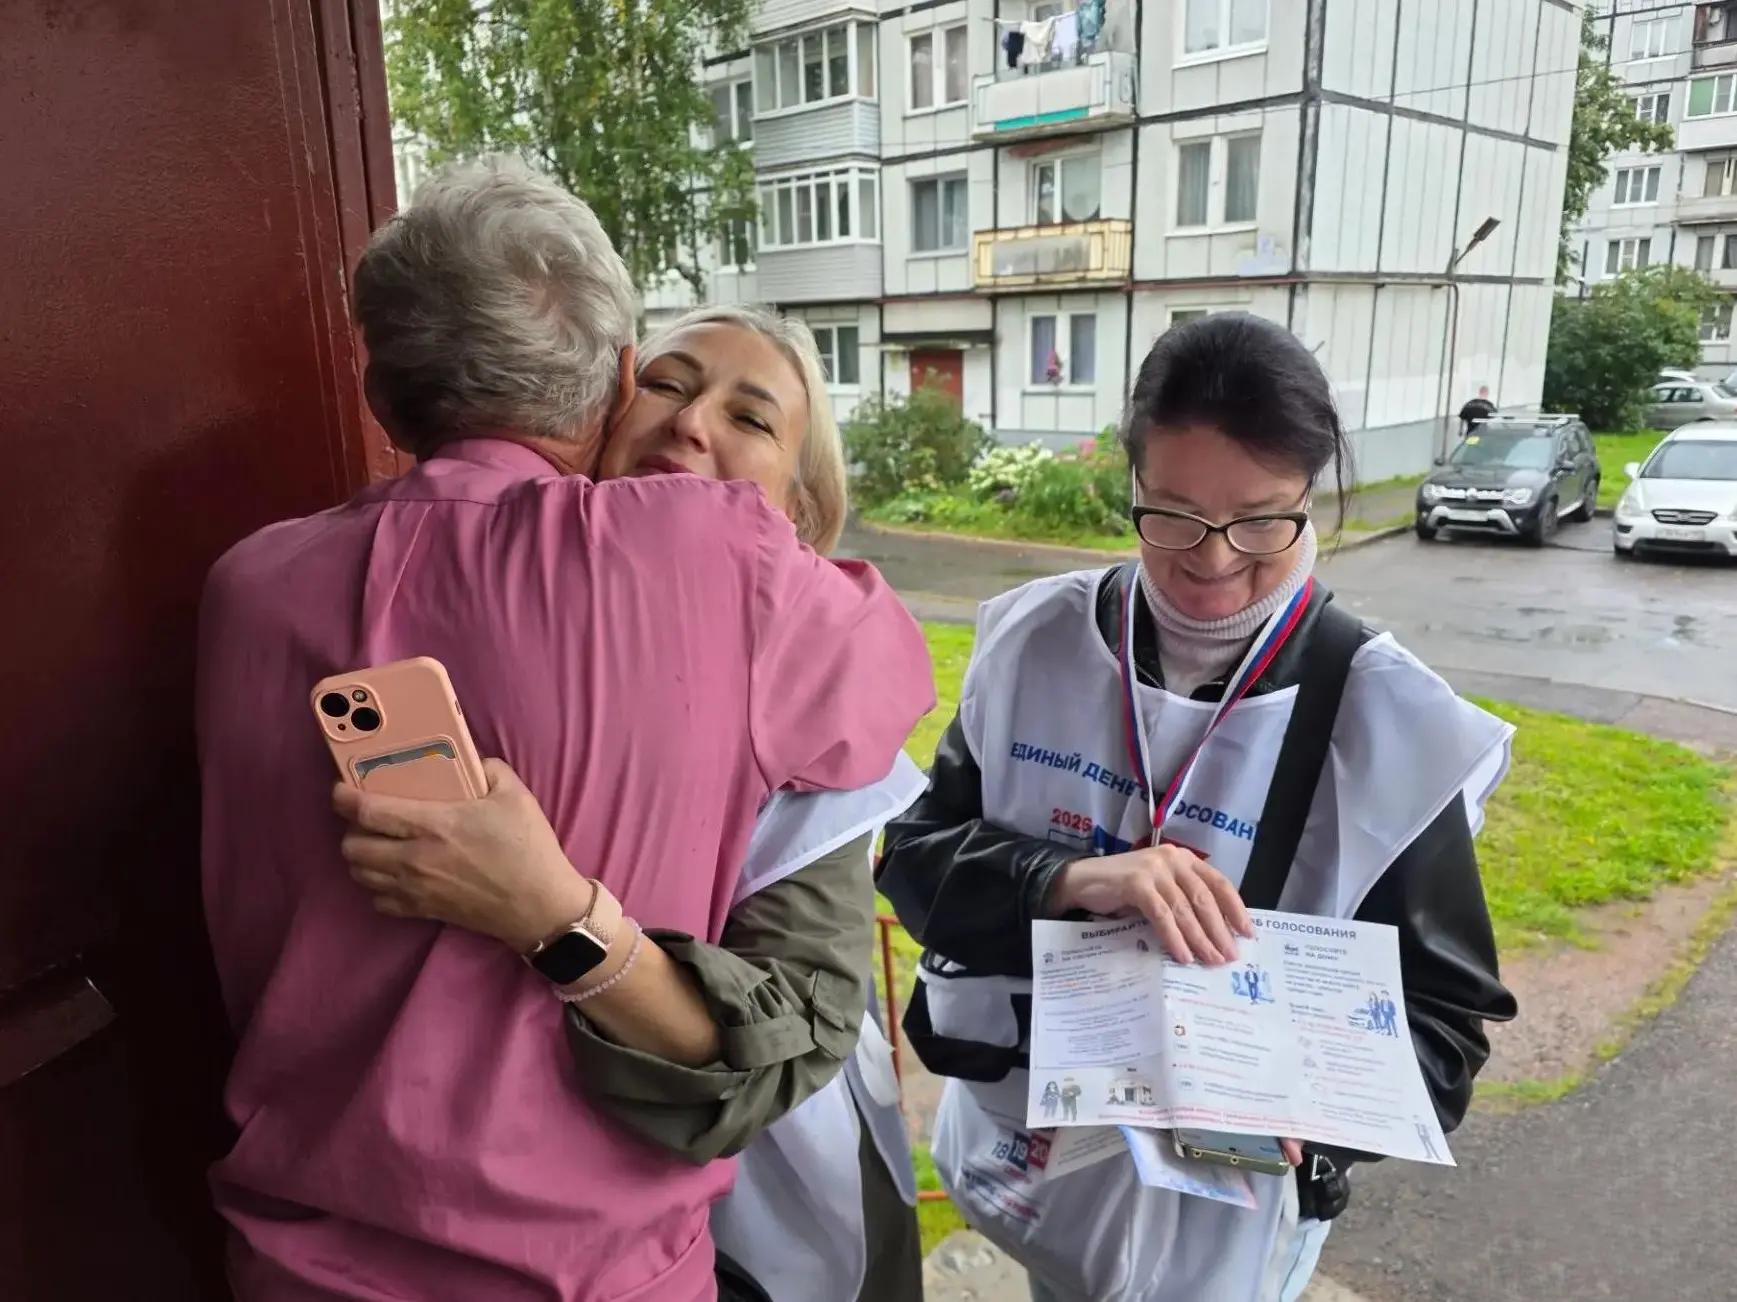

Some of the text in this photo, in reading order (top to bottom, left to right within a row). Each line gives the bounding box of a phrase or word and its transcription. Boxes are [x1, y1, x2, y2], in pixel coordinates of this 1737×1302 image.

[1010, 742, 1082, 773] ЕДИНЫЙ
[1266, 919, 1357, 940] ГОЛОСОВАНИЯ
[991, 1140, 1009, 1160] 18
[1012, 1139, 1028, 1161] 19
